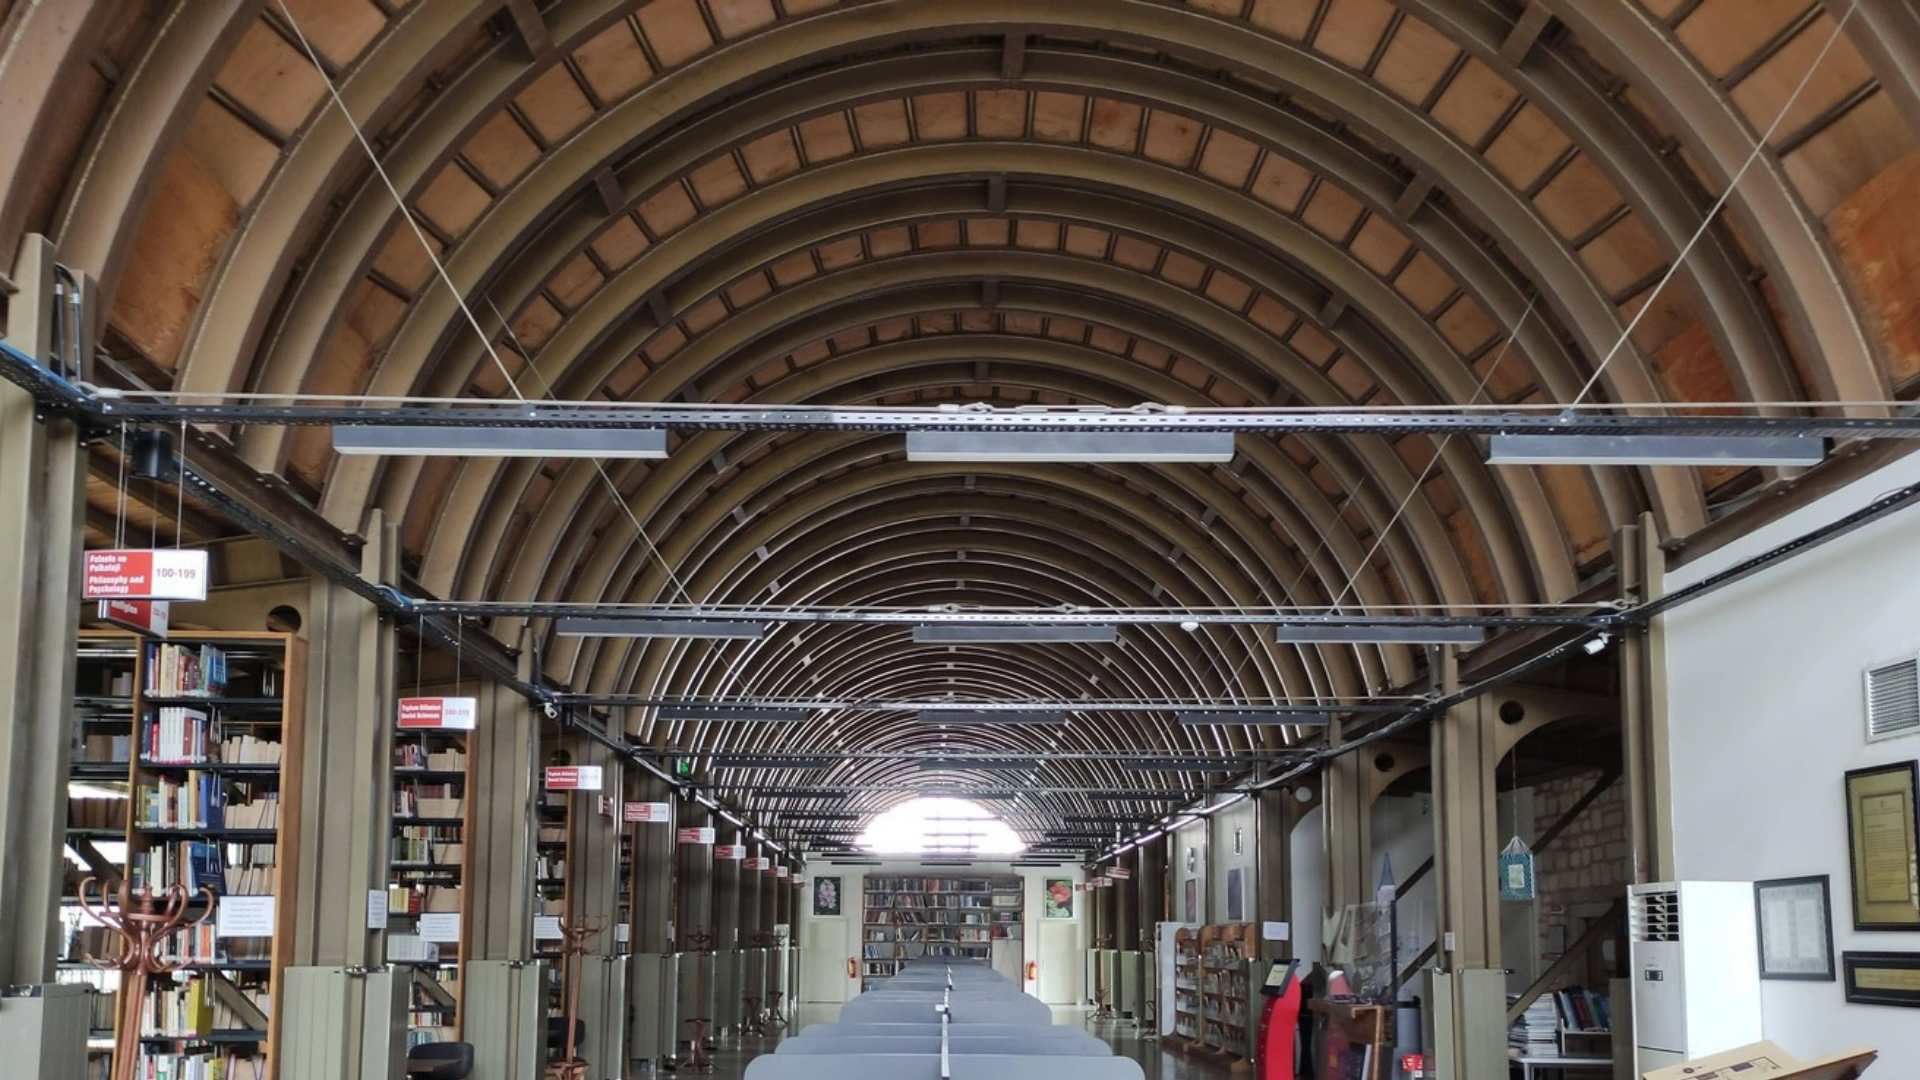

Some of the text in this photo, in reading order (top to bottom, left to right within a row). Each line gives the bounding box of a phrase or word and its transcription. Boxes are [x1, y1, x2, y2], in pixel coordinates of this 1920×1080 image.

[117, 555, 127, 563] ve
[156, 568, 197, 579] 100-199
[88, 575, 145, 585] Philosophy and
[88, 584, 129, 594] Psychology
